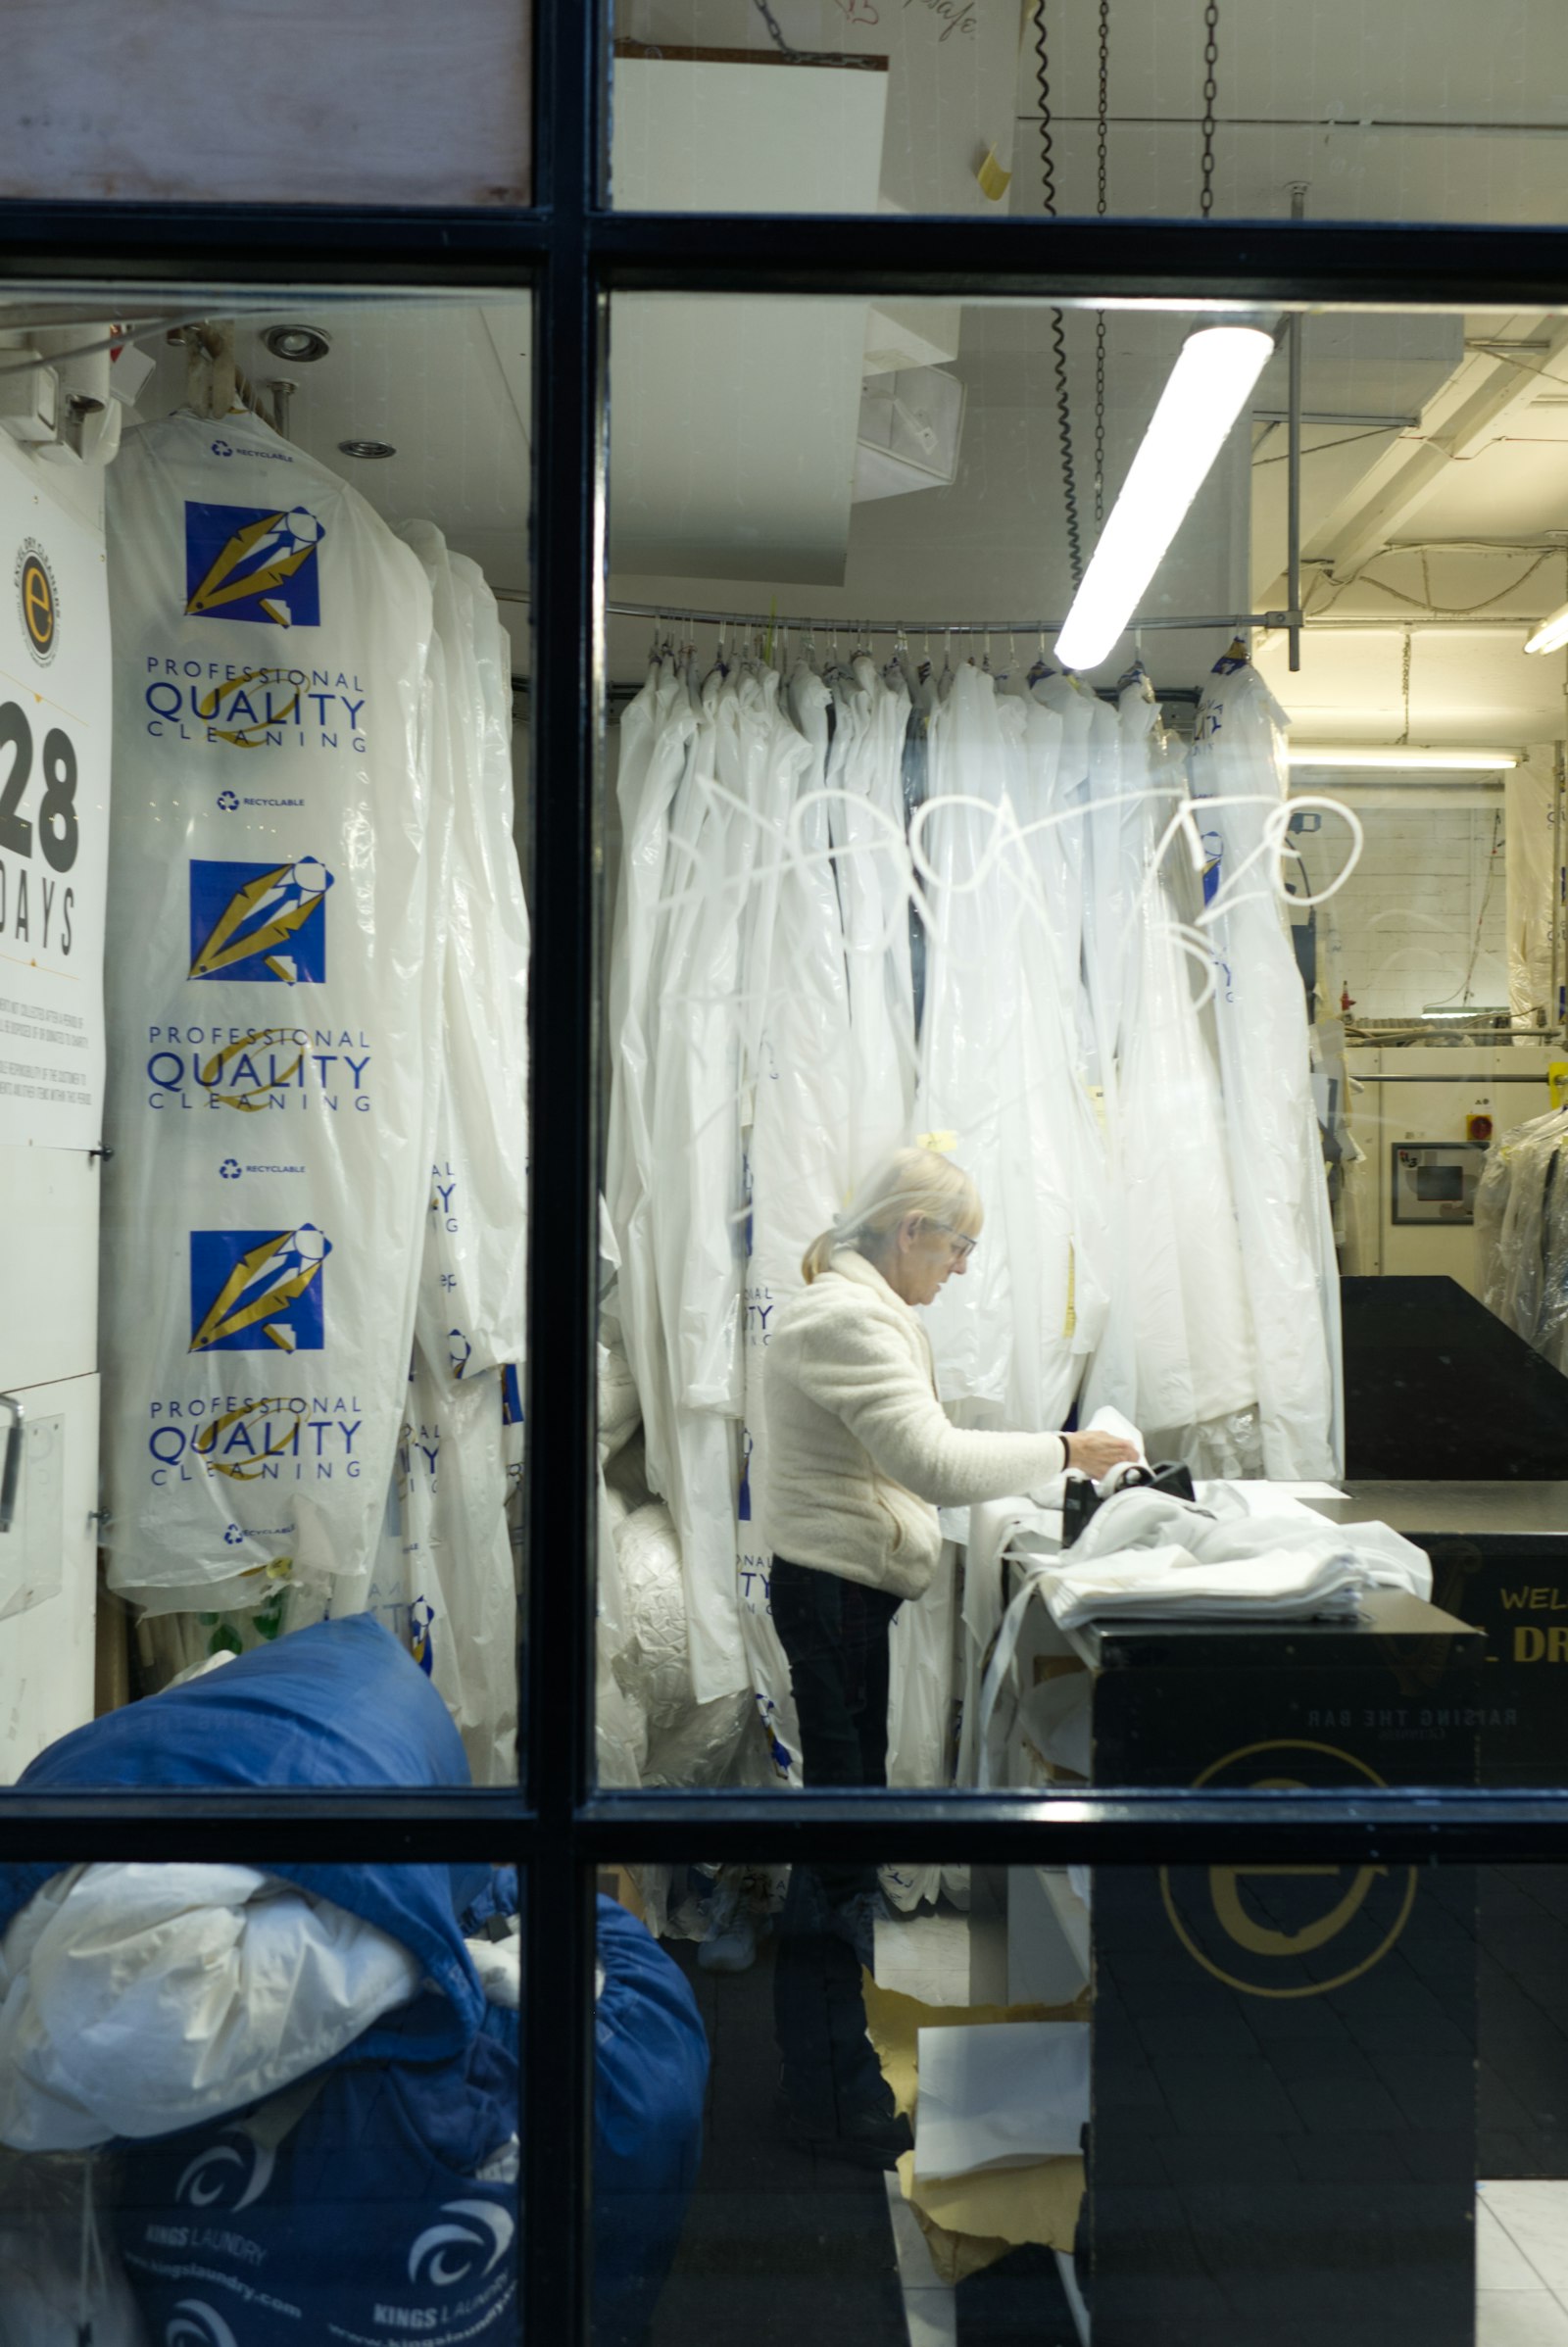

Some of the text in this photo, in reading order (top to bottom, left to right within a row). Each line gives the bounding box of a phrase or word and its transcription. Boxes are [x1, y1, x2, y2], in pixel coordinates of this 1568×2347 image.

[236, 448, 294, 463] RECYCLABLE
[147, 657, 364, 692] PROFESSIONAL
[145, 681, 366, 730] QUALITY
[147, 720, 367, 753] CLEANING
[0, 701, 78, 873] 28
[243, 798, 306, 807] RECYCLABLE
[149, 1027, 370, 1048] PROFESSIONAL
[147, 1051, 371, 1093] QUALITY
[148, 1093, 370, 1112] CLEANING
[246, 1165, 307, 1174] RECYCLABLE
[150, 1395, 362, 1418] PROFESSIONAL
[149, 1420, 363, 1466] QUALITY
[151, 1461, 361, 1486] CLEANING
[189, 2226, 268, 2268] LAUNDRY
[372, 2302, 438, 2330] KINGS
